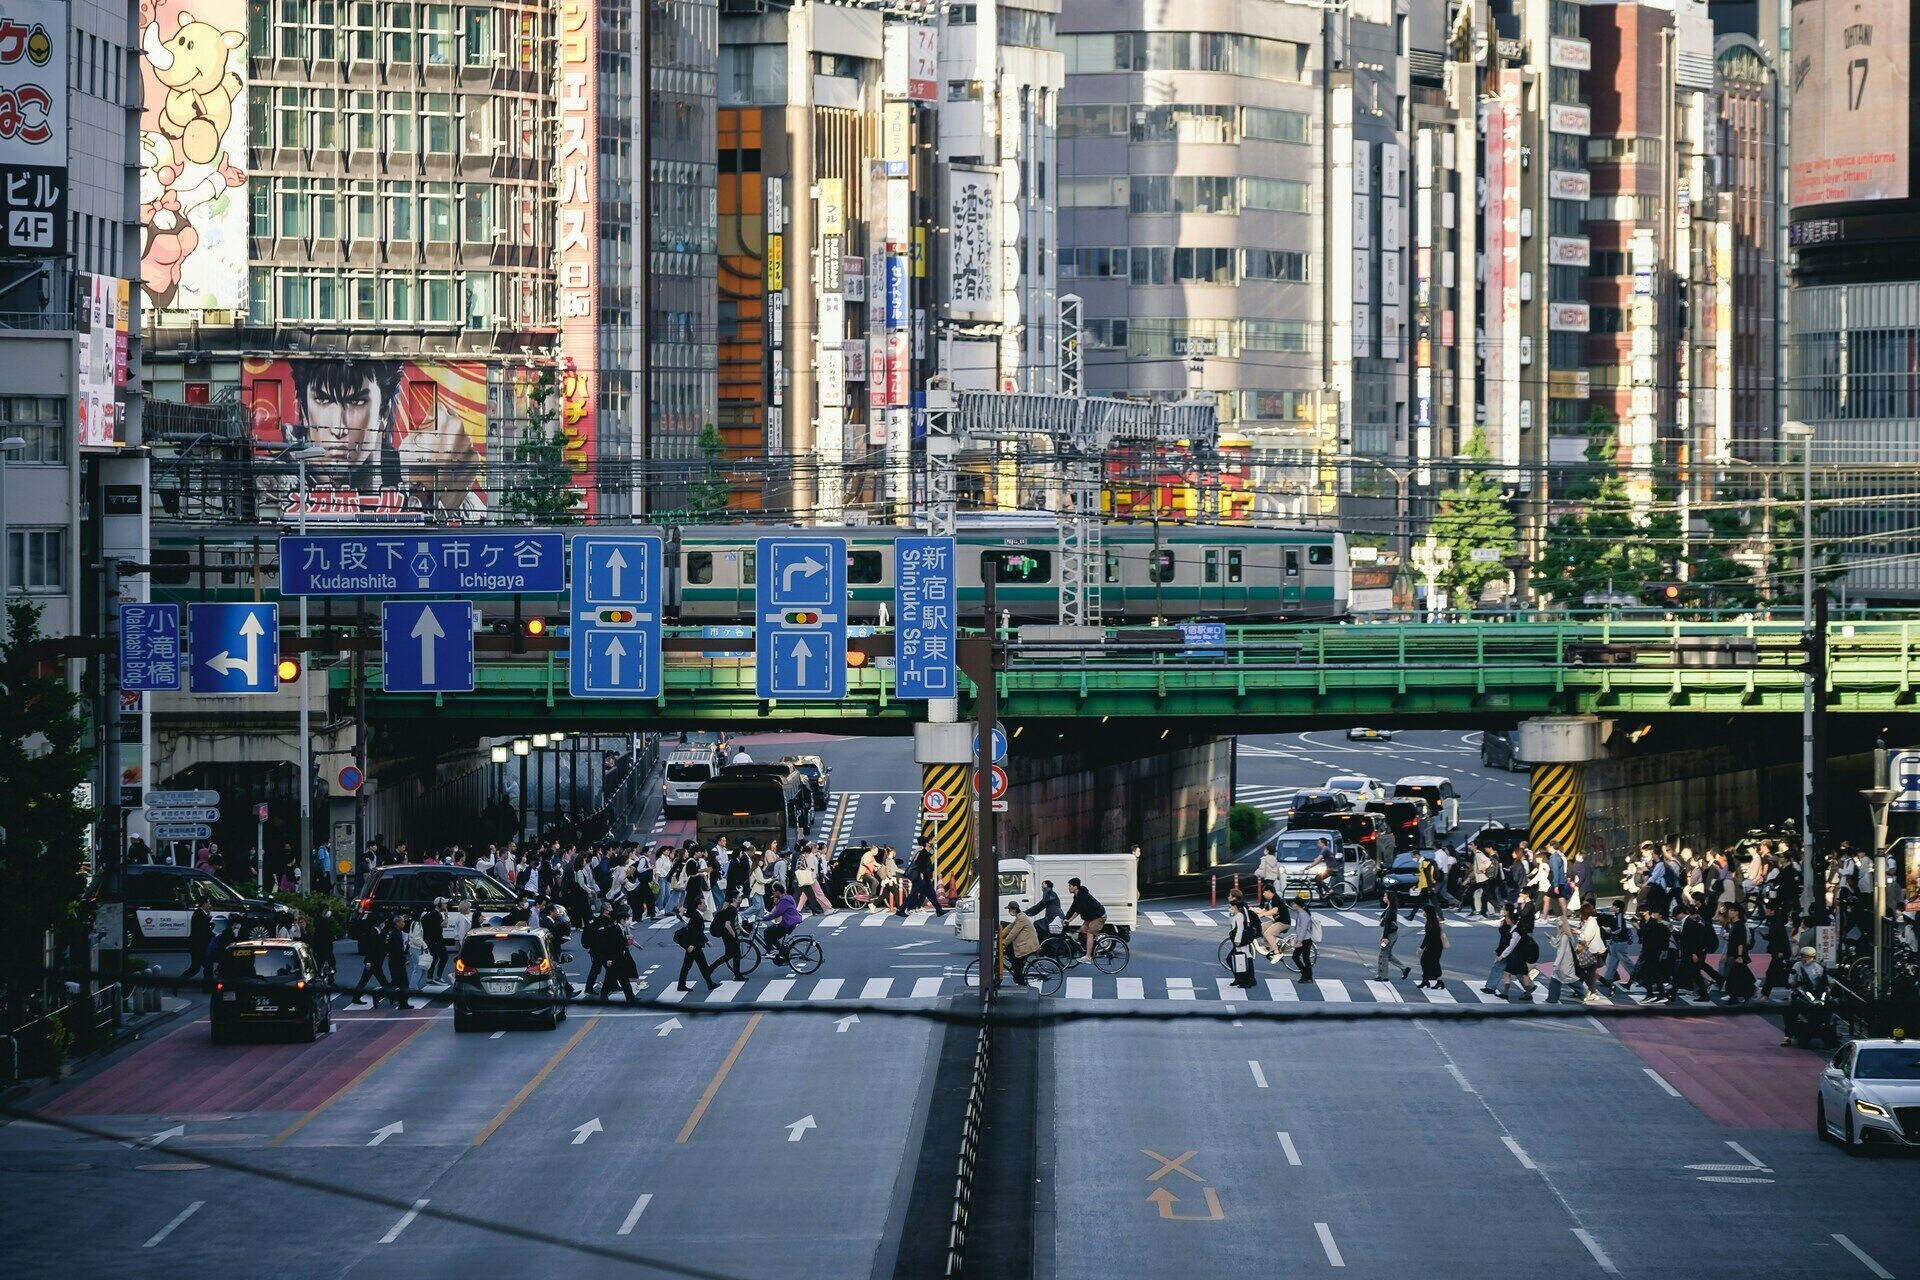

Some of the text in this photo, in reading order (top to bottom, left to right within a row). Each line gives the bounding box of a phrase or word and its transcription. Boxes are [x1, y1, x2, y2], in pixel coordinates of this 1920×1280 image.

[1843, 24, 1872, 49] OHTANI
[1847, 58, 1868, 111] 17
[6, 172, 60, 208] ビル
[13, 216, 48, 243] 4F
[564, 371, 589, 472] パチンコ
[302, 541, 405, 571] 九段下
[418, 558, 429, 573] 4
[310, 573, 397, 590] Kudanshita
[459, 573, 525, 590] Ichigaya
[902, 549, 921, 621] Shinjuku
[922, 545, 948, 689] 新宿駅東口
[125, 609, 146, 659] Otakibashi
[147, 610, 176, 684] 小滝橋
[123, 662, 146, 687] Brdg.
